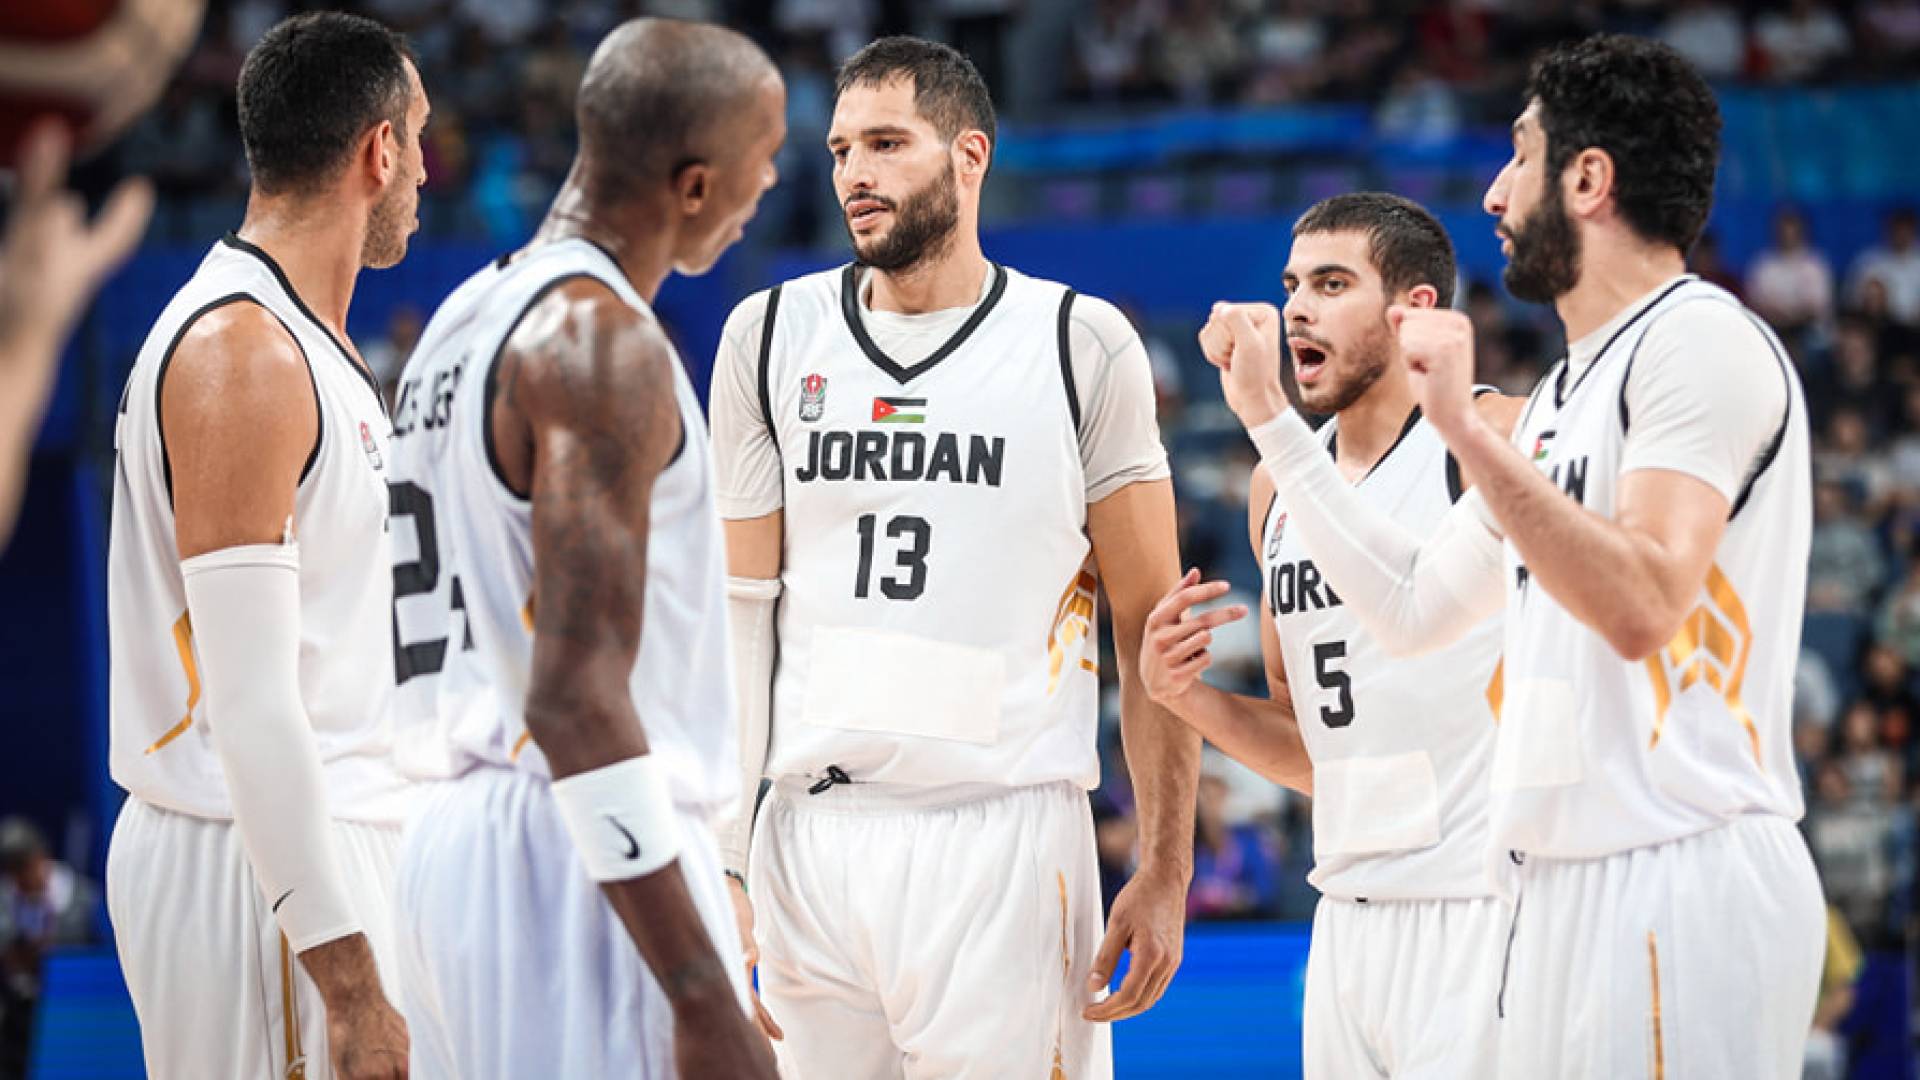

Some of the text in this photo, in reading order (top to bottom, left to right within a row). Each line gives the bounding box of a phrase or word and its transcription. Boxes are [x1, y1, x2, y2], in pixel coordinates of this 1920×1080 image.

[795, 431, 1005, 487] JORDAN
[854, 512, 931, 600] 13
[1313, 640, 1355, 728] 5
